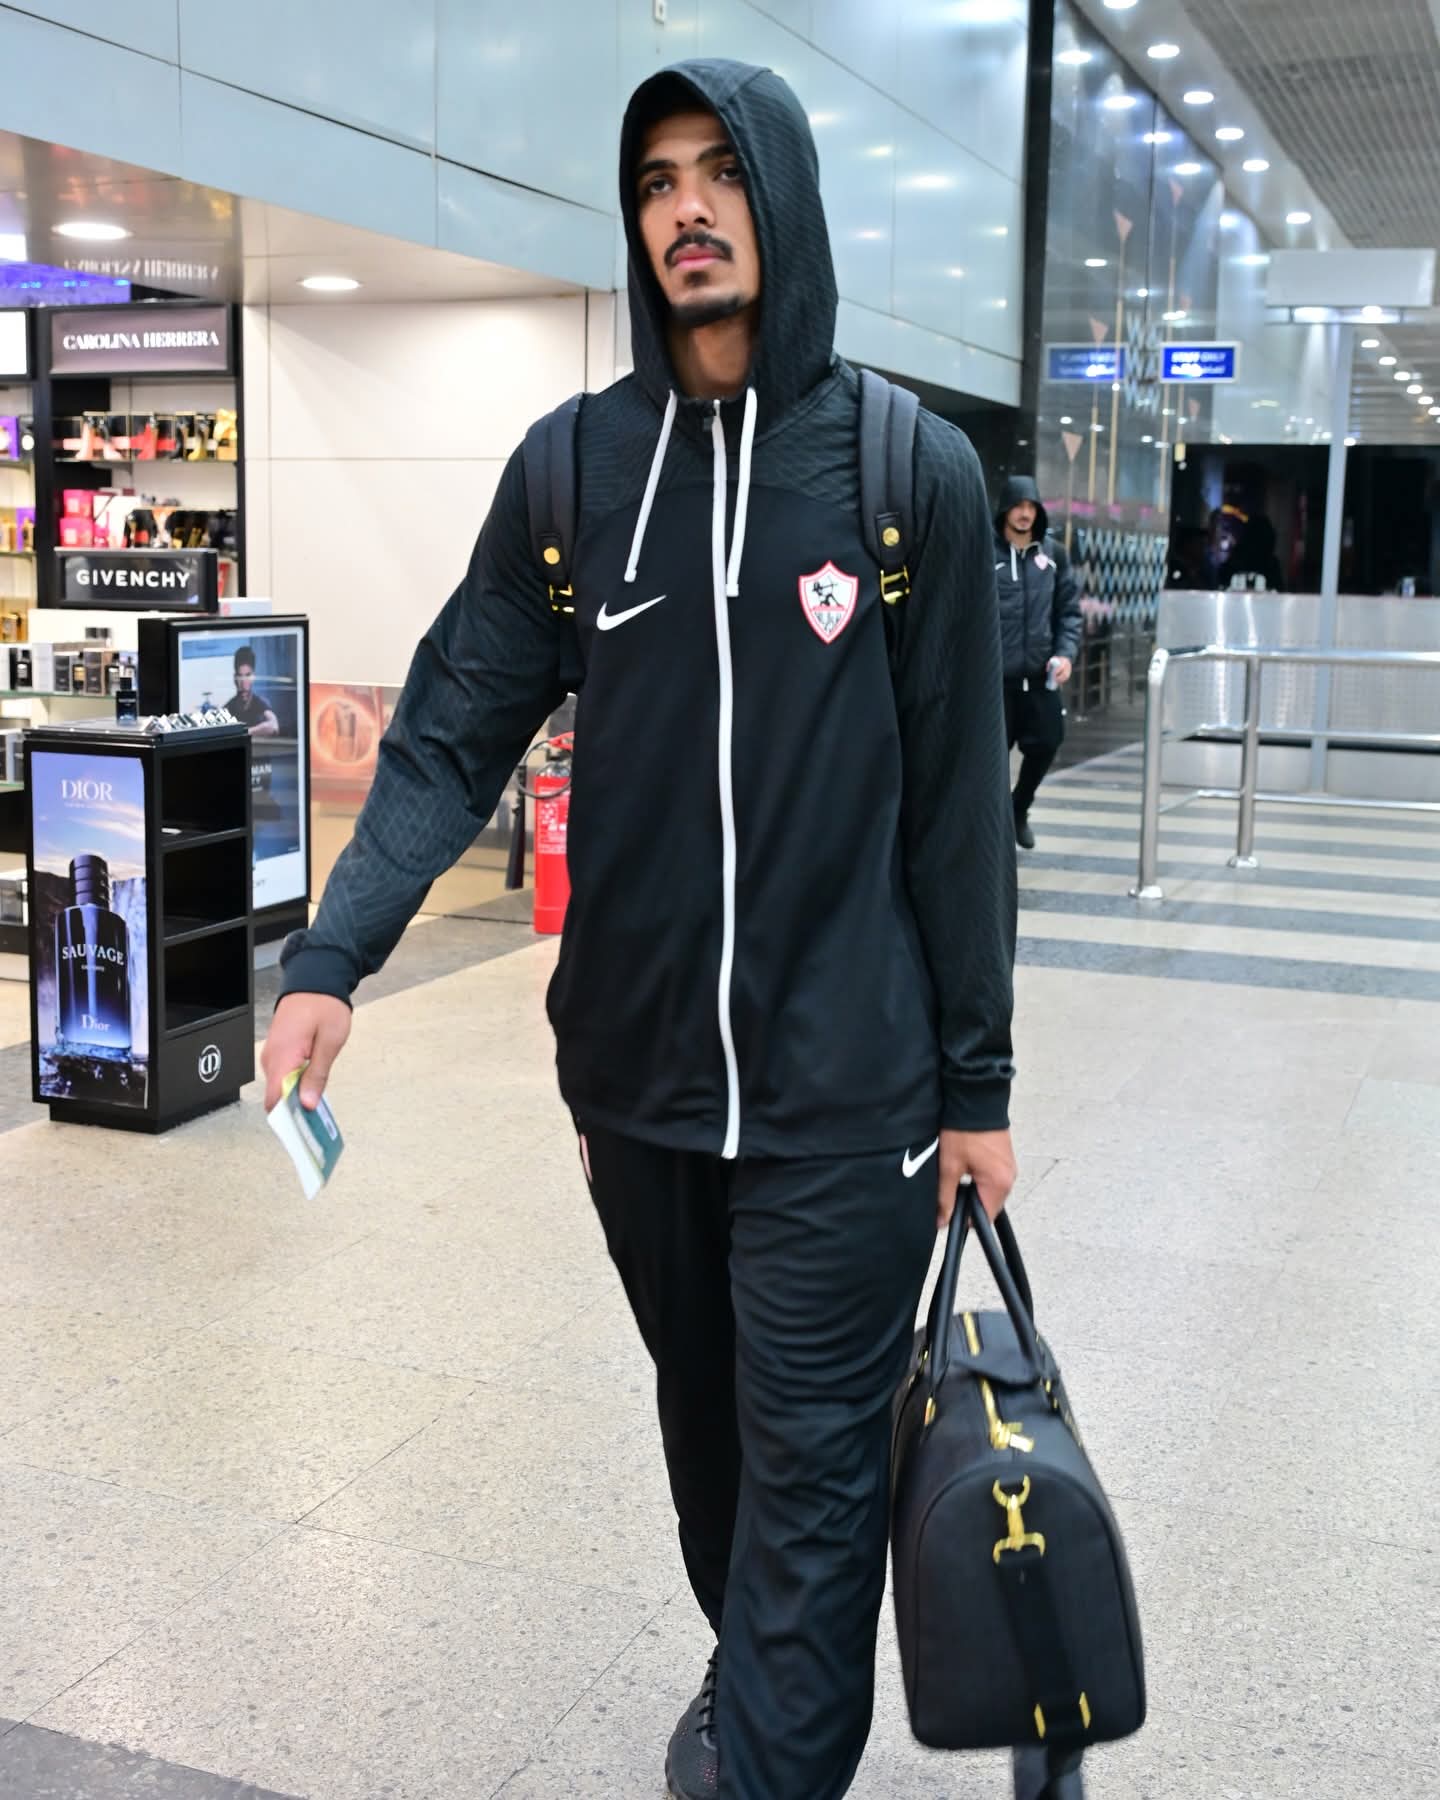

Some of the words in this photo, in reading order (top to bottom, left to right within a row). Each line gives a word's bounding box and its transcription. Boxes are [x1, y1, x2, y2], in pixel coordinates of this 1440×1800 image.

[63, 333, 140, 349] CAROLINA
[143, 330, 219, 347] HERRERA
[76, 569, 190, 587] GIVENCHY
[62, 779, 113, 801] DIOR
[62, 943, 124, 966] SAUVAGE
[82, 1014, 111, 1031] Dior
